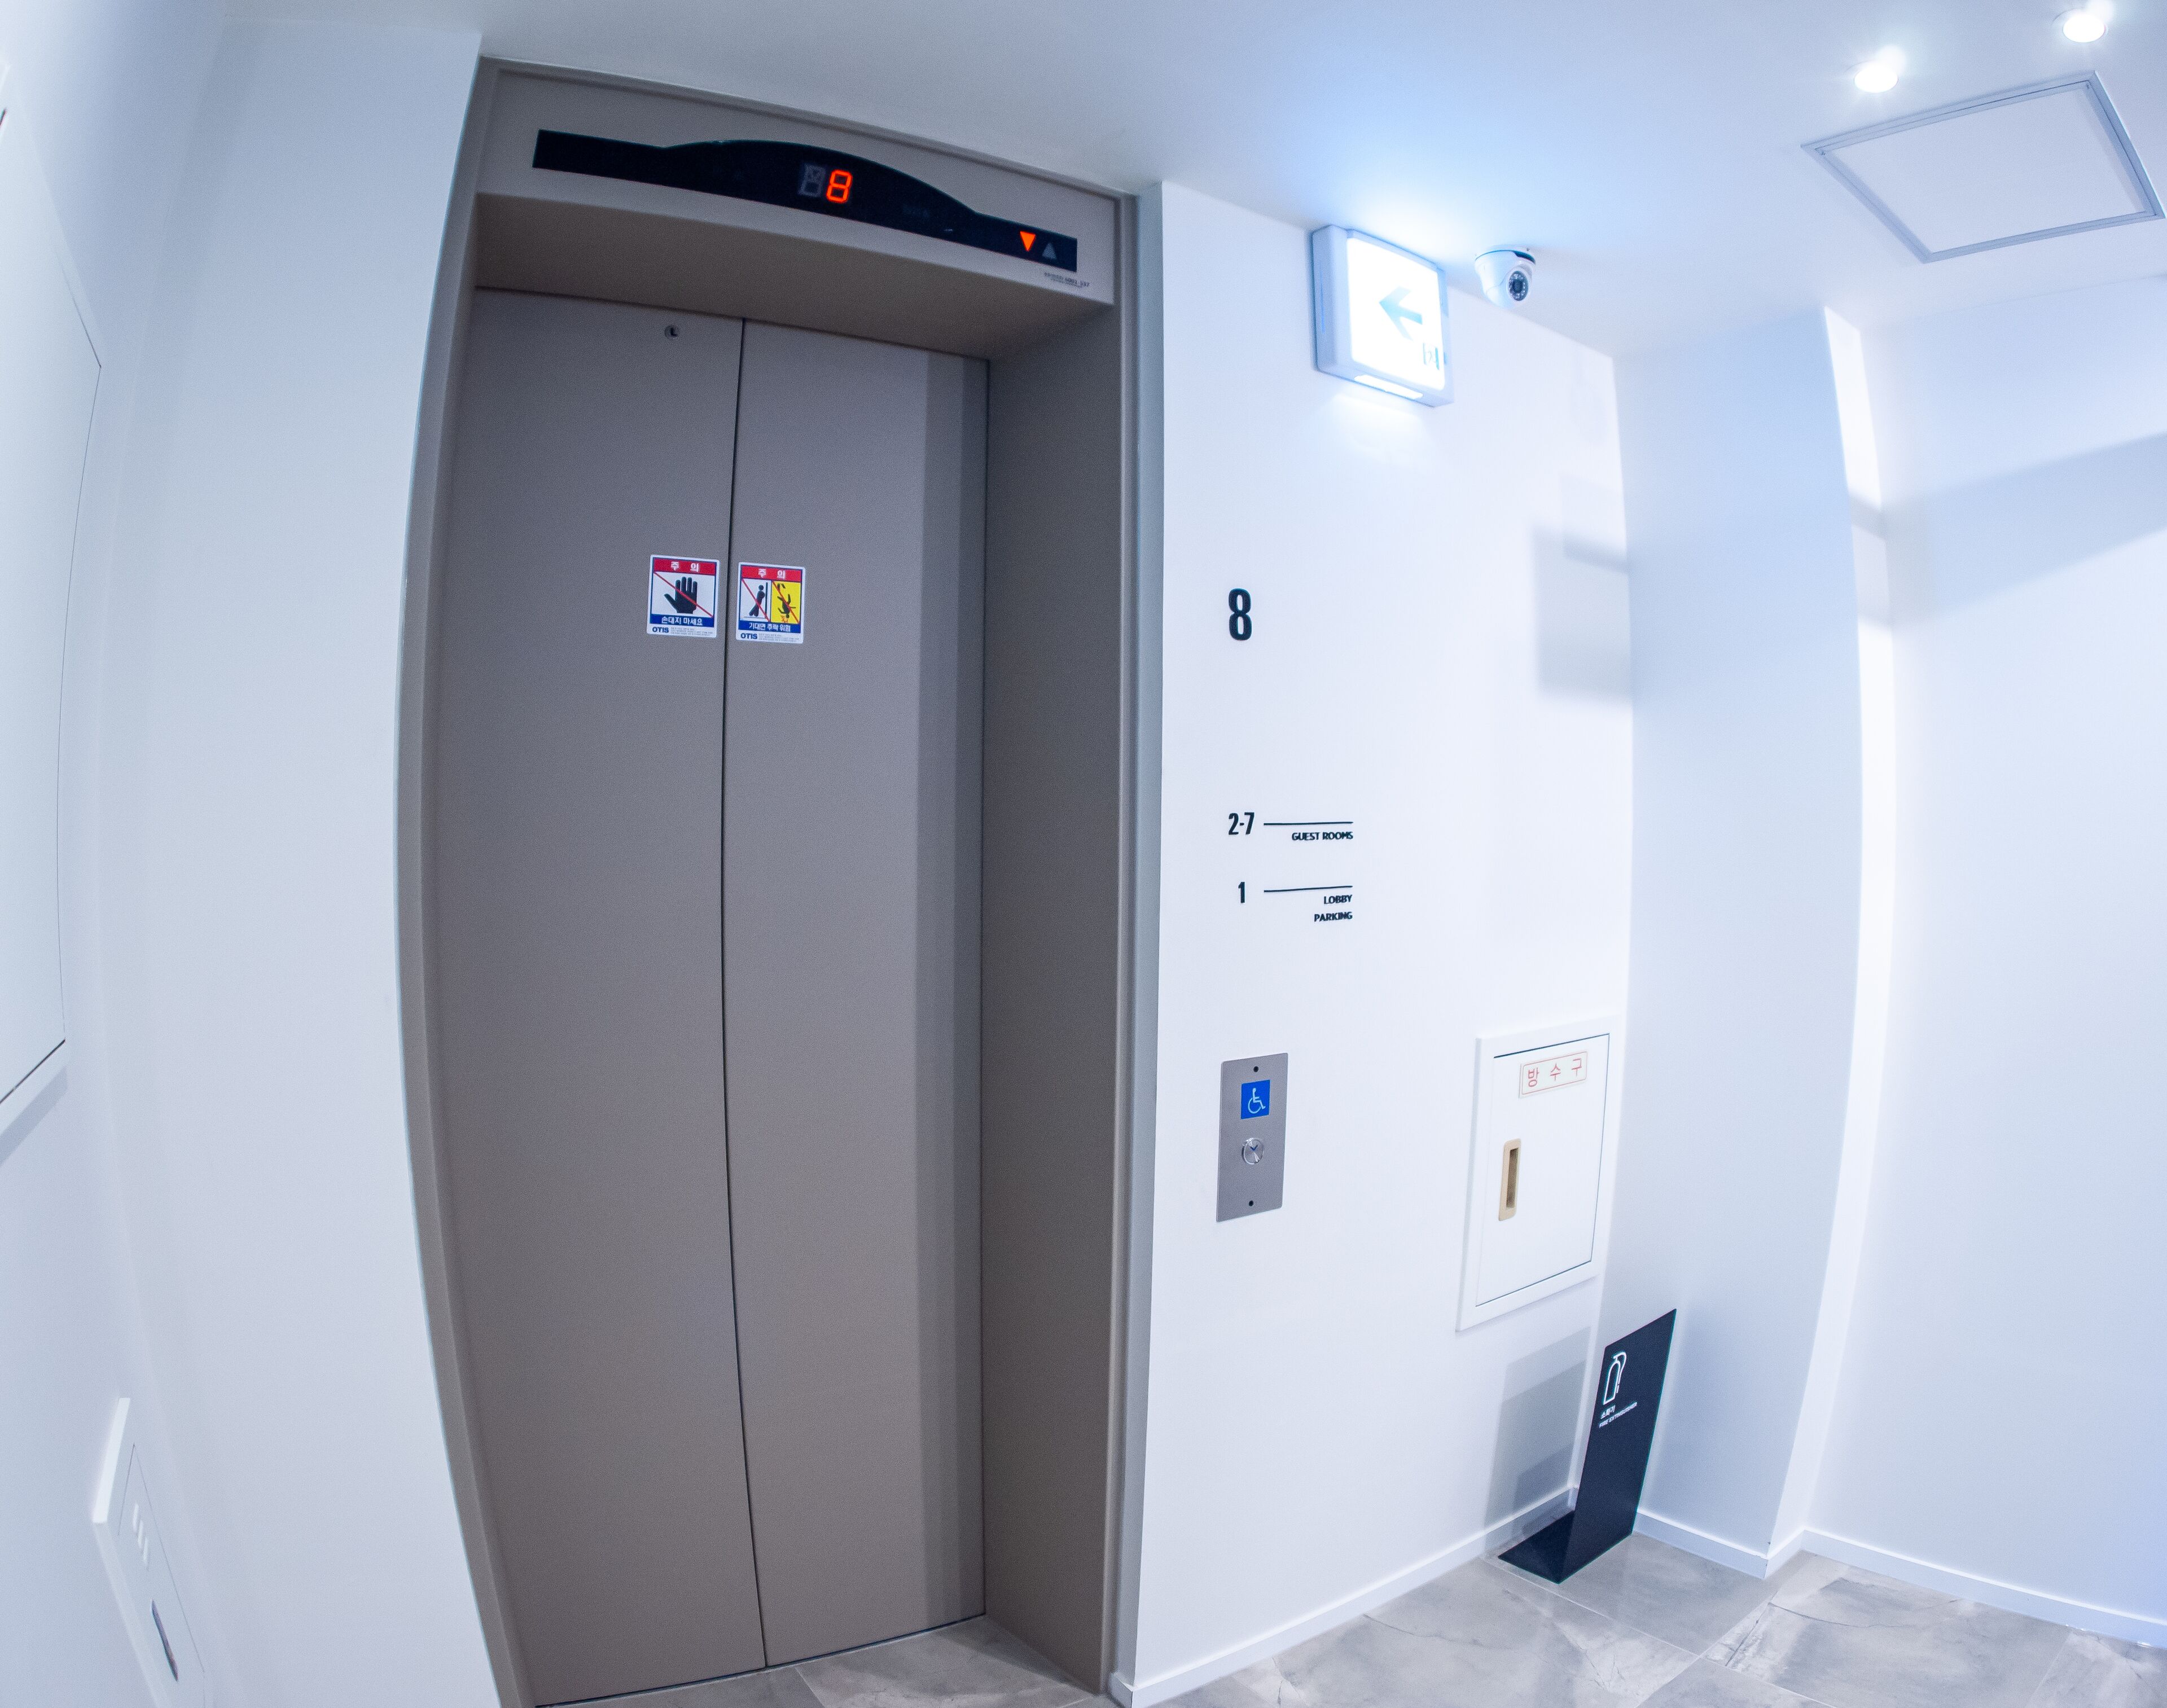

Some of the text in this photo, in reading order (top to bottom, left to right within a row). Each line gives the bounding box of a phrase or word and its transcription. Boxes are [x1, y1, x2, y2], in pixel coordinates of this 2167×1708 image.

[826, 169, 853, 203] 8
[661, 616, 681, 625] 손대지
[1229, 589, 1253, 642] 8
[1228, 812, 1255, 836] 2-7
[1292, 831, 1354, 841] GUEST ROOMS
[1238, 881, 1246, 904] 1
[1324, 894, 1353, 905] LOBBY
[1314, 911, 1353, 923] PARKING
